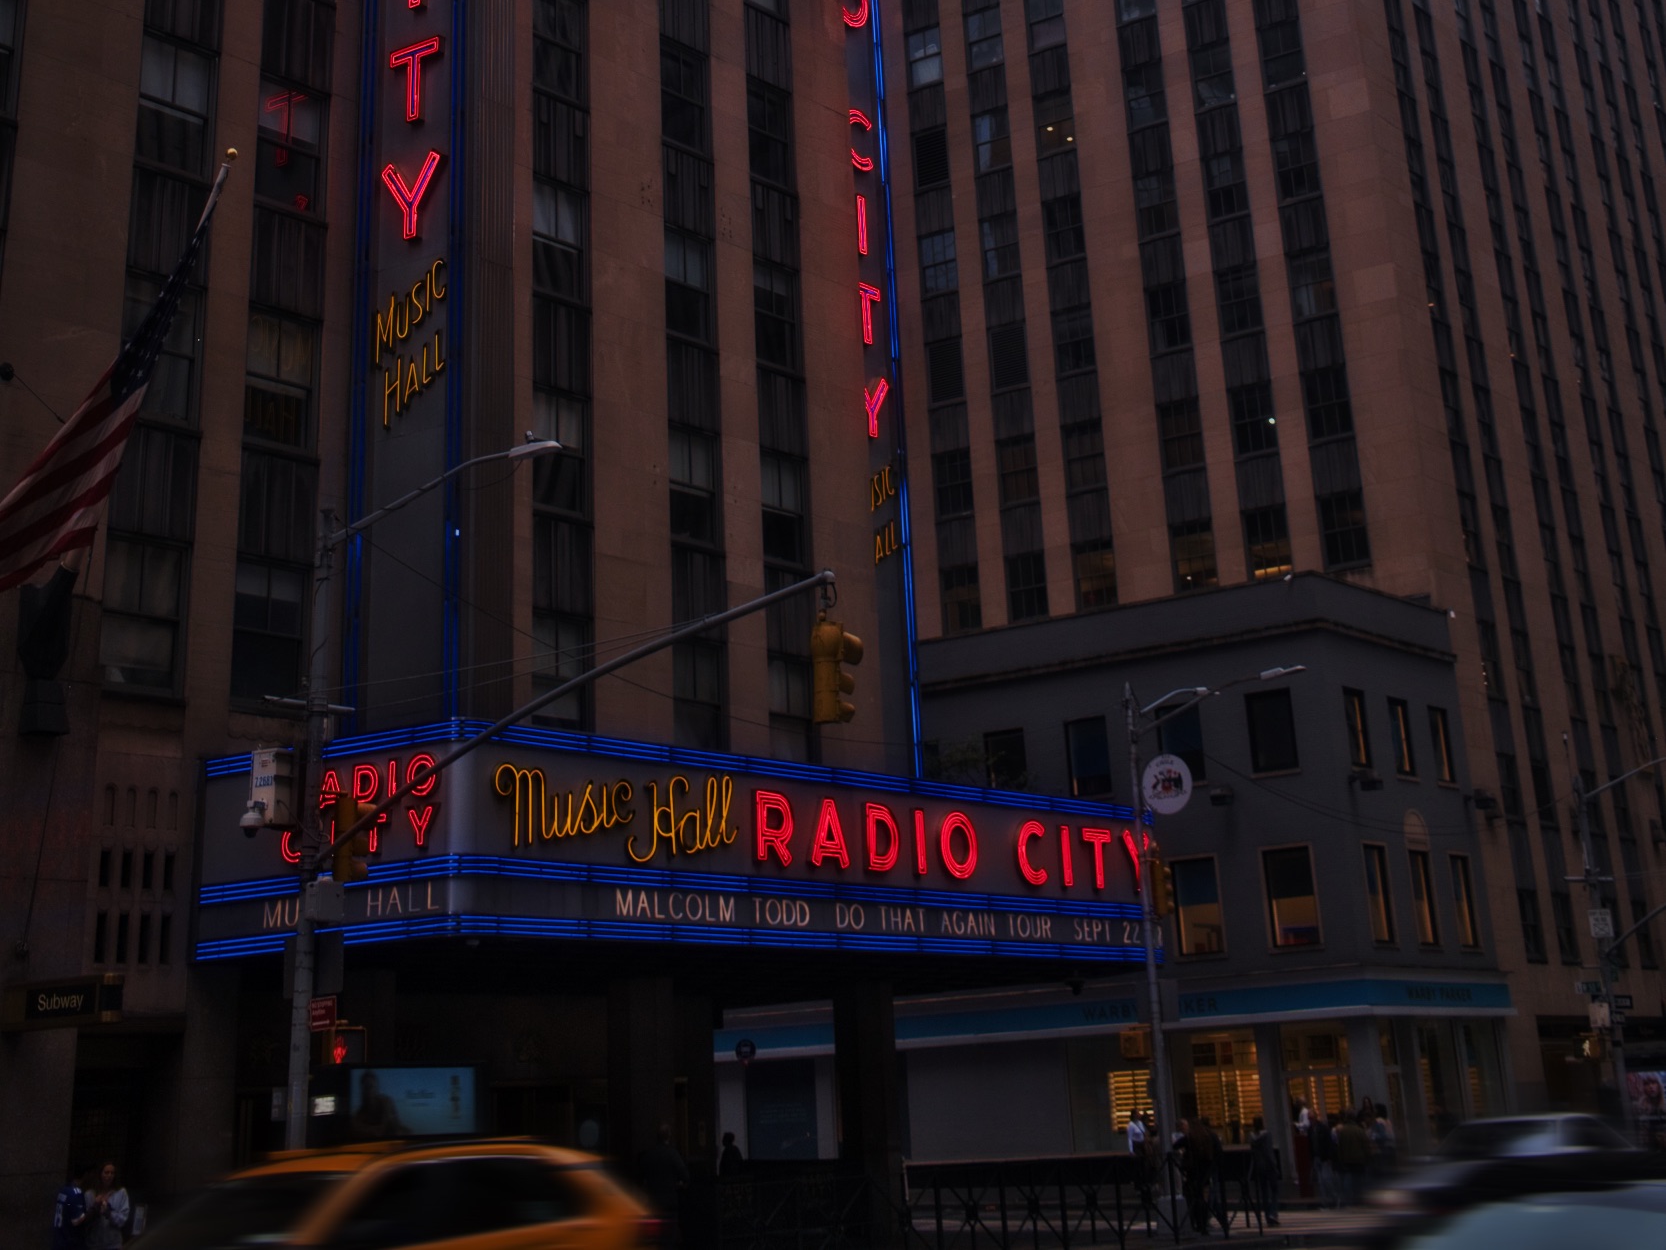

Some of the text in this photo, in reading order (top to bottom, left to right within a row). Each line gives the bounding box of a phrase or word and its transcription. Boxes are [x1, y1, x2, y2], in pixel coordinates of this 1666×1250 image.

[375, 258, 447, 365] MUSIC
[382, 329, 446, 429] HALL
[874, 519, 898, 565] ALL
[320, 753, 437, 810] ADIO
[494, 763, 635, 848] Music
[628, 774, 739, 864] Hall
[755, 788, 978, 882] RADIO
[367, 880, 440, 917] HALL
[615, 887, 736, 924] MALCOLM
[751, 896, 811, 928] TODD
[835, 902, 866, 930] DO
[879, 904, 926, 934] THAT
[941, 910, 996, 938] AGAIN
[1007, 913, 1052, 940] TOUR
[1073, 917, 1111, 943] SEPT
[1122, 920, 1141, 944] 22
[37, 993, 84, 1011] Subway
[1082, 997, 1218, 1022] WARB KER
